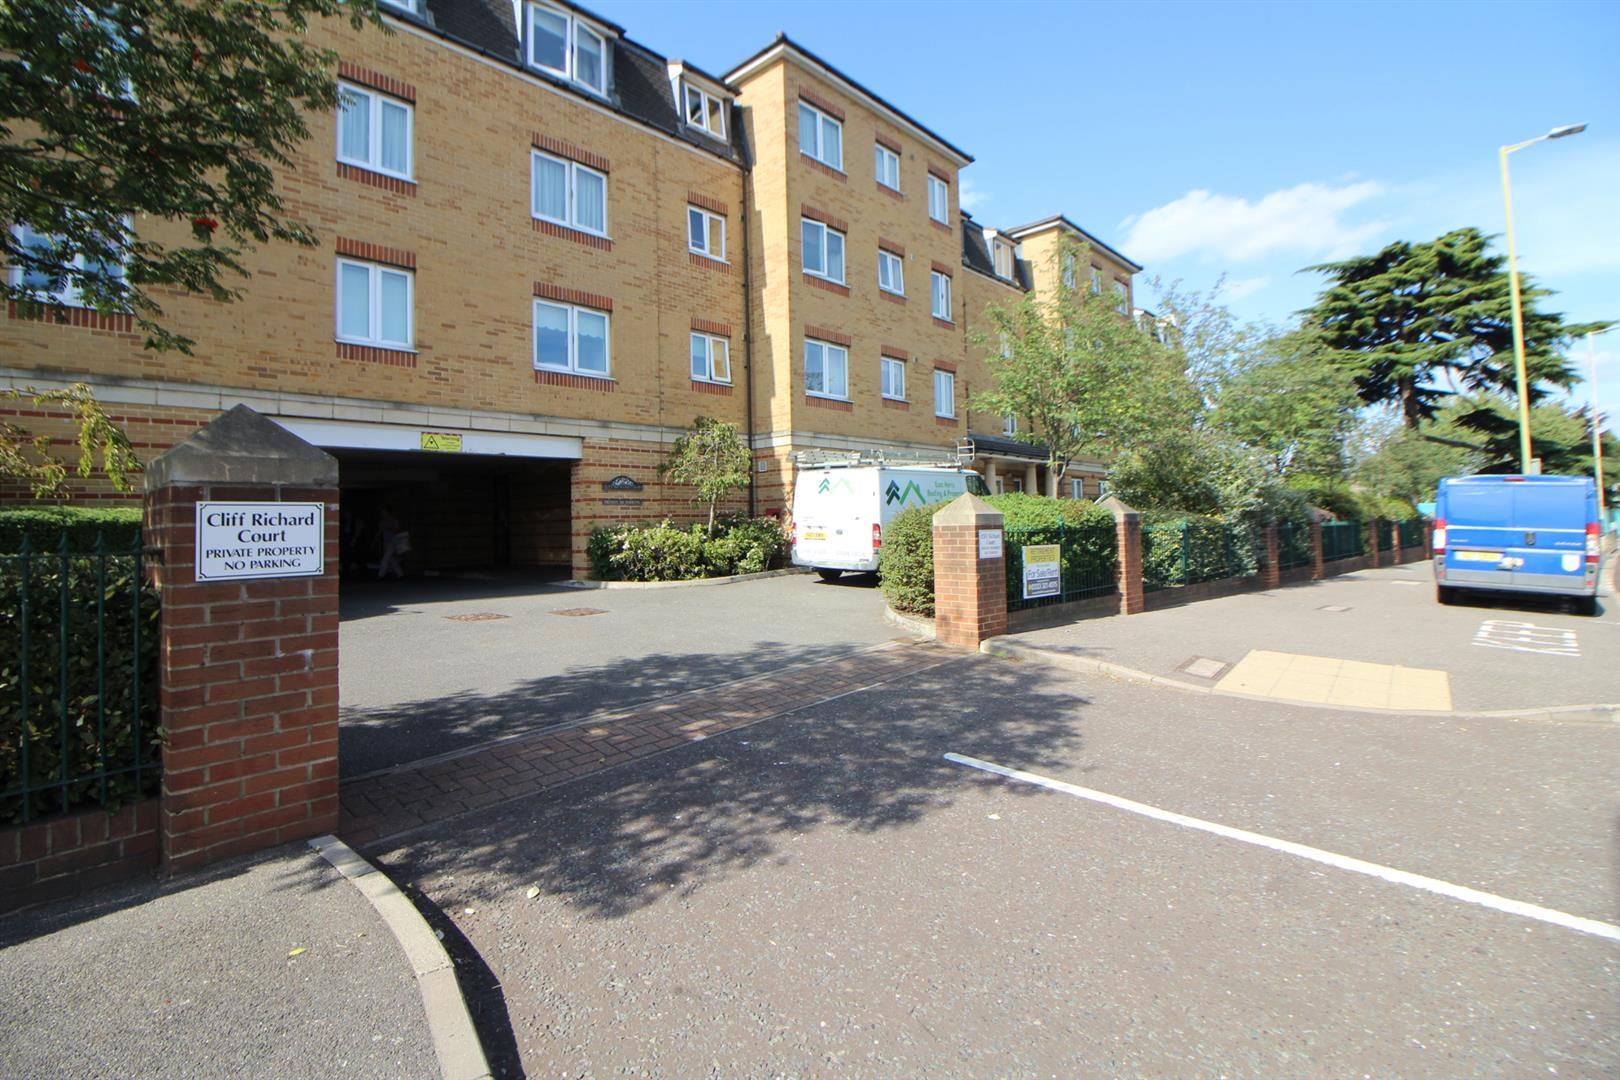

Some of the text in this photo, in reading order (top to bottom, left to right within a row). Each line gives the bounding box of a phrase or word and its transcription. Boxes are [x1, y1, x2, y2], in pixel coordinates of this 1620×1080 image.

[207, 512, 315, 527] Cliff Richard
[237, 529, 286, 543] Court
[205, 546, 316, 559] PRIVATE PROPERTY
[224, 558, 301, 571] NO PARKING
